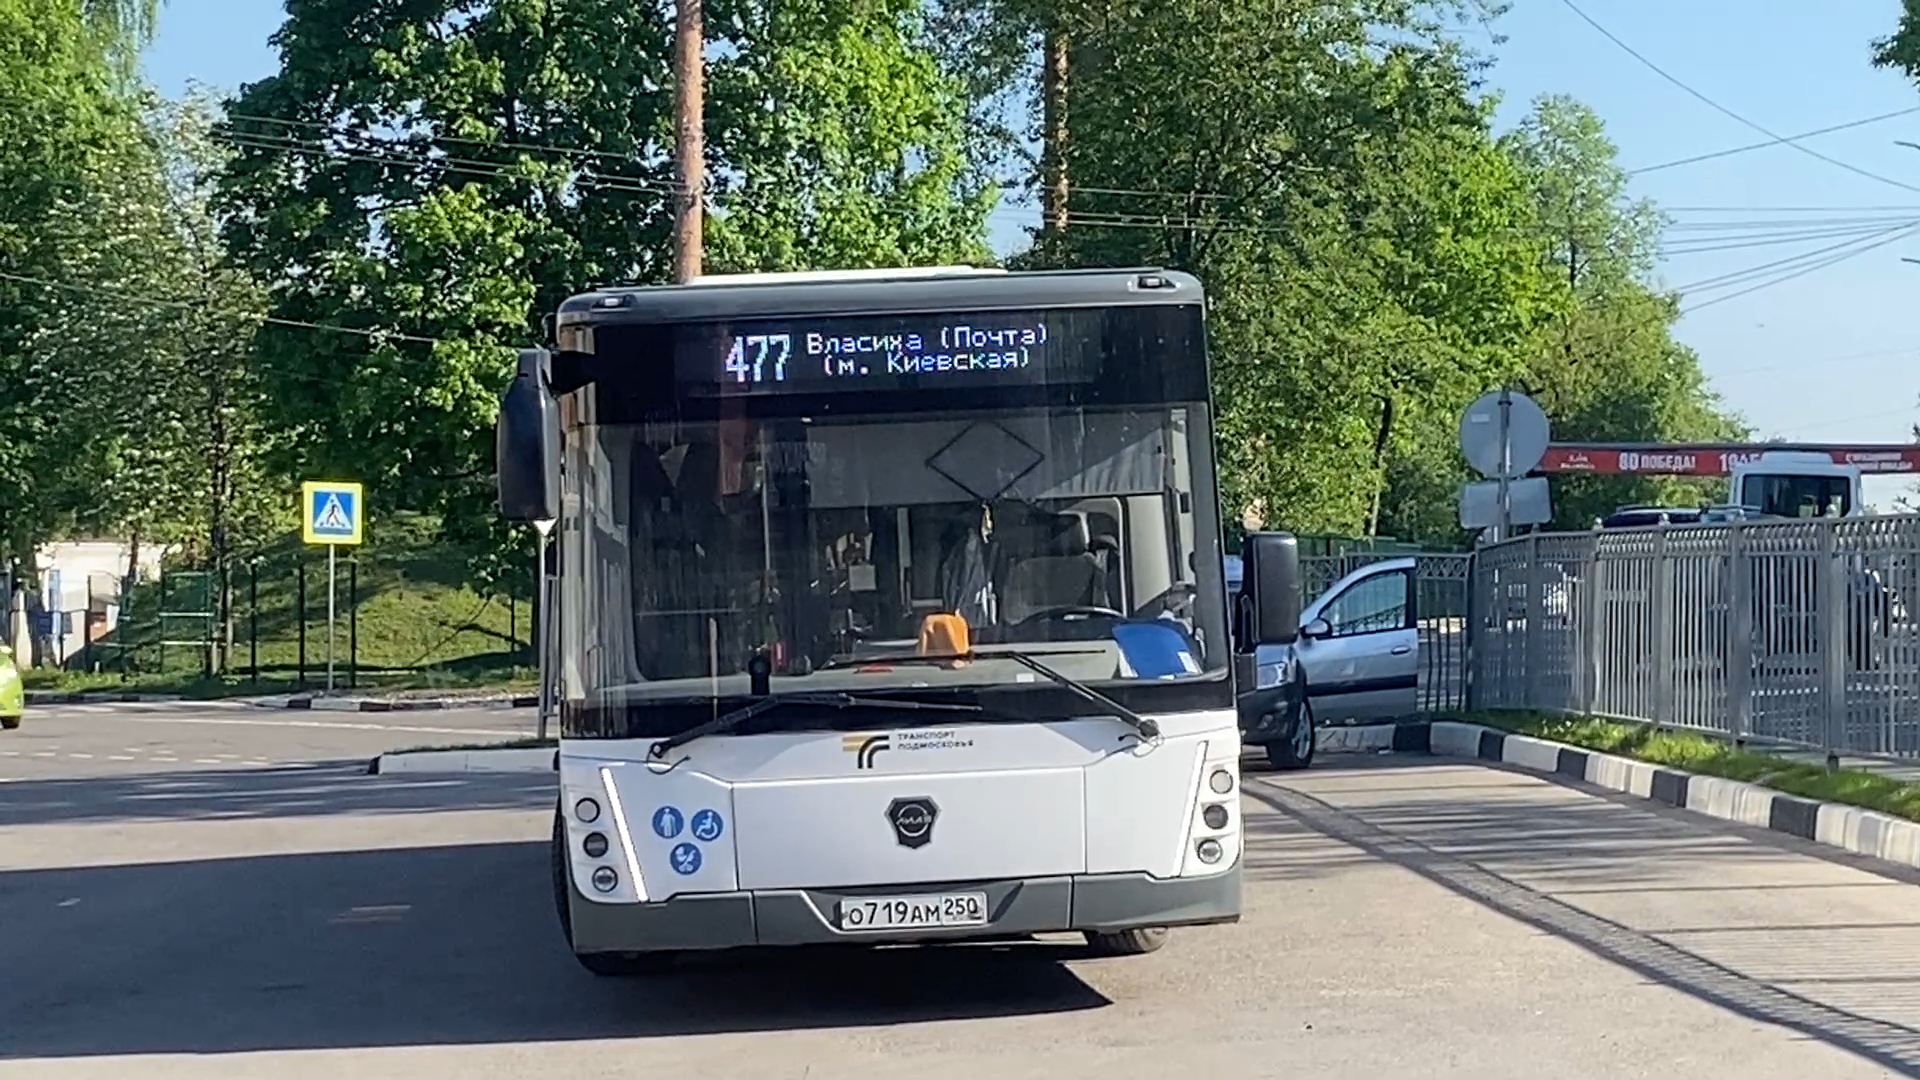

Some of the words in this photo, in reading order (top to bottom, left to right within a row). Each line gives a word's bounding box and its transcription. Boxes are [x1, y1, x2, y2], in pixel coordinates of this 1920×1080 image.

[805, 332, 923, 355] Власиха
[940, 322, 1048, 350] (Почта)
[725, 334, 791, 383] 477
[823, 355, 869, 376] (м.
[886, 346, 1030, 374] Киевская)
[1640, 454, 1696, 471] ПОБЕДА!
[897, 731, 956, 740] ТРАНСПОРТ
[944, 897, 978, 915] 250
